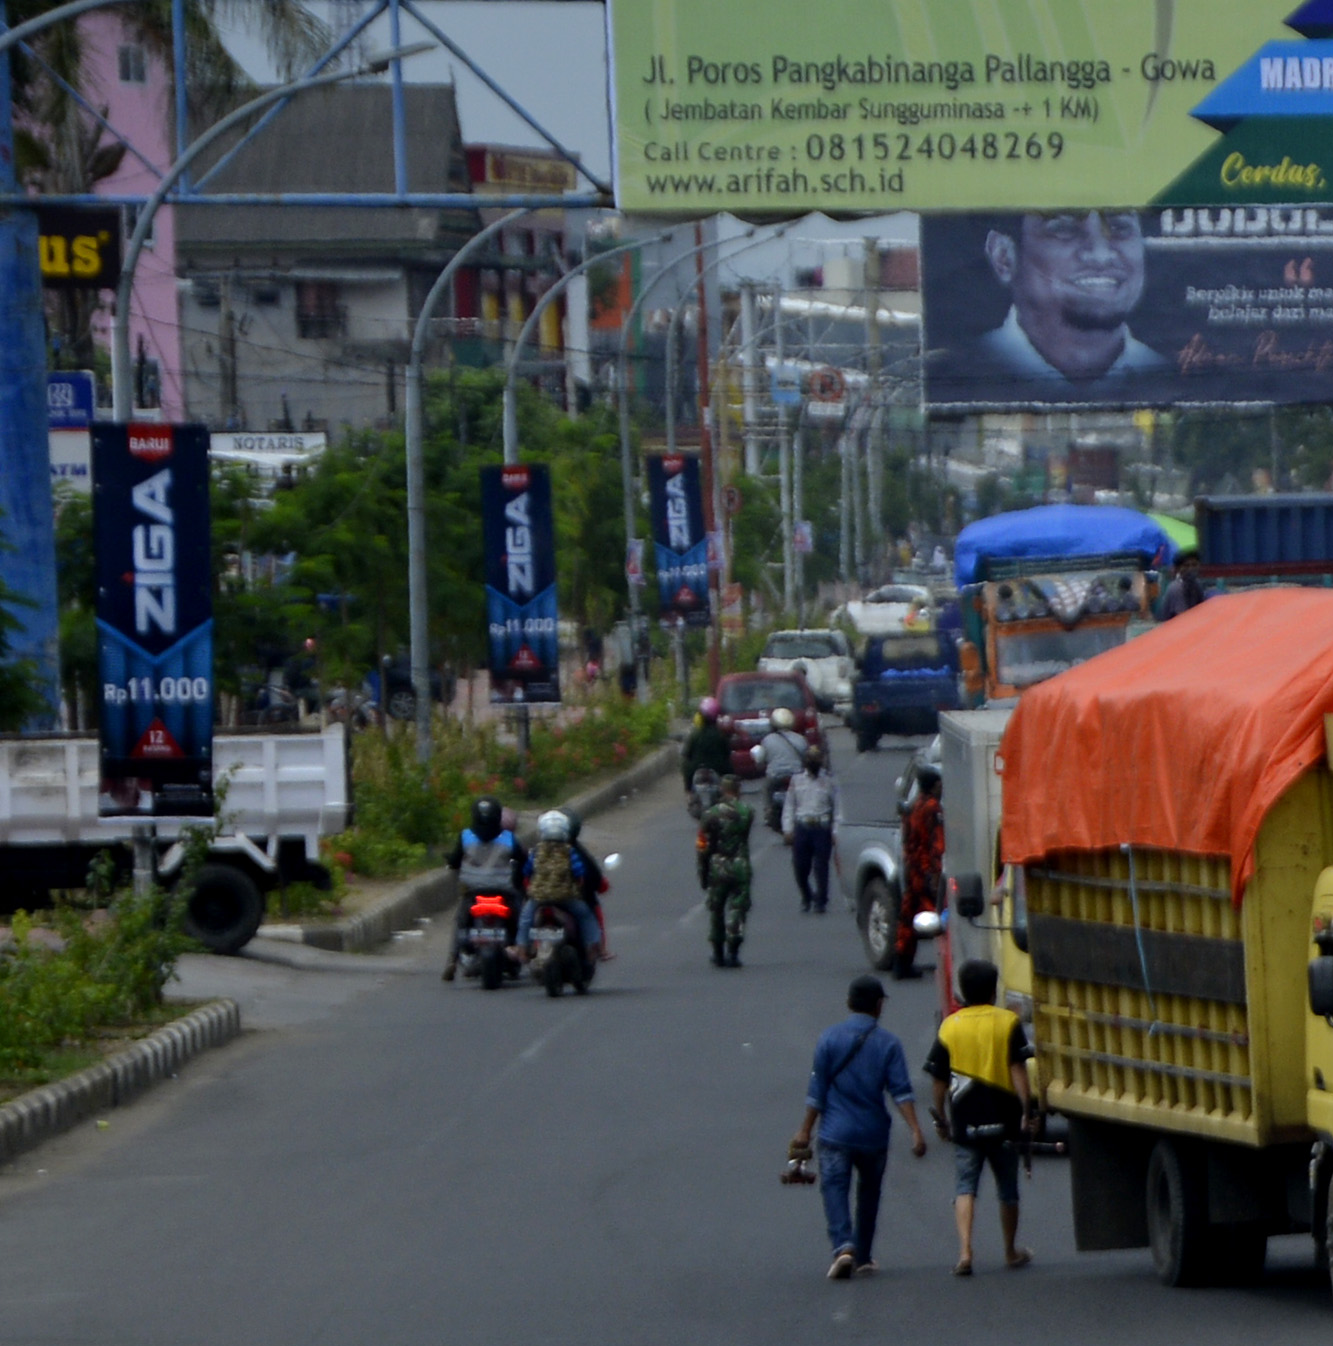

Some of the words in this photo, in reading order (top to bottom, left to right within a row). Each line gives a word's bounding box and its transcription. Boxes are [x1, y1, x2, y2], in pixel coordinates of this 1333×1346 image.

[643, 55, 674, 84] Jl.
[687, 56, 762, 84] Poros
[772, 55, 975, 90] Pangkabinanga
[986, 54, 1111, 88] Pallangga
[1141, 55, 1216, 81] Gowa
[660, 98, 762, 120] Jembatan
[772, 98, 851, 119] Kembar
[859, 98, 1004, 124] Sungguminasa
[1060, 98, 1099, 123] KM)
[644, 142, 688, 161] Call
[699, 141, 782, 161] Centre
[806, 133, 1064, 160] 081524048269
[646, 167, 904, 194] www.arifah.sch.id
[1220, 152, 1326, 189] Cerdas,
[232, 435, 305, 450] NOTARIS
[666, 473, 691, 549] ZIGA
[132, 467, 177, 636] ZIGA
[505, 492, 535, 597] ZIGA
[104, 676, 208, 704] Rp11.000
